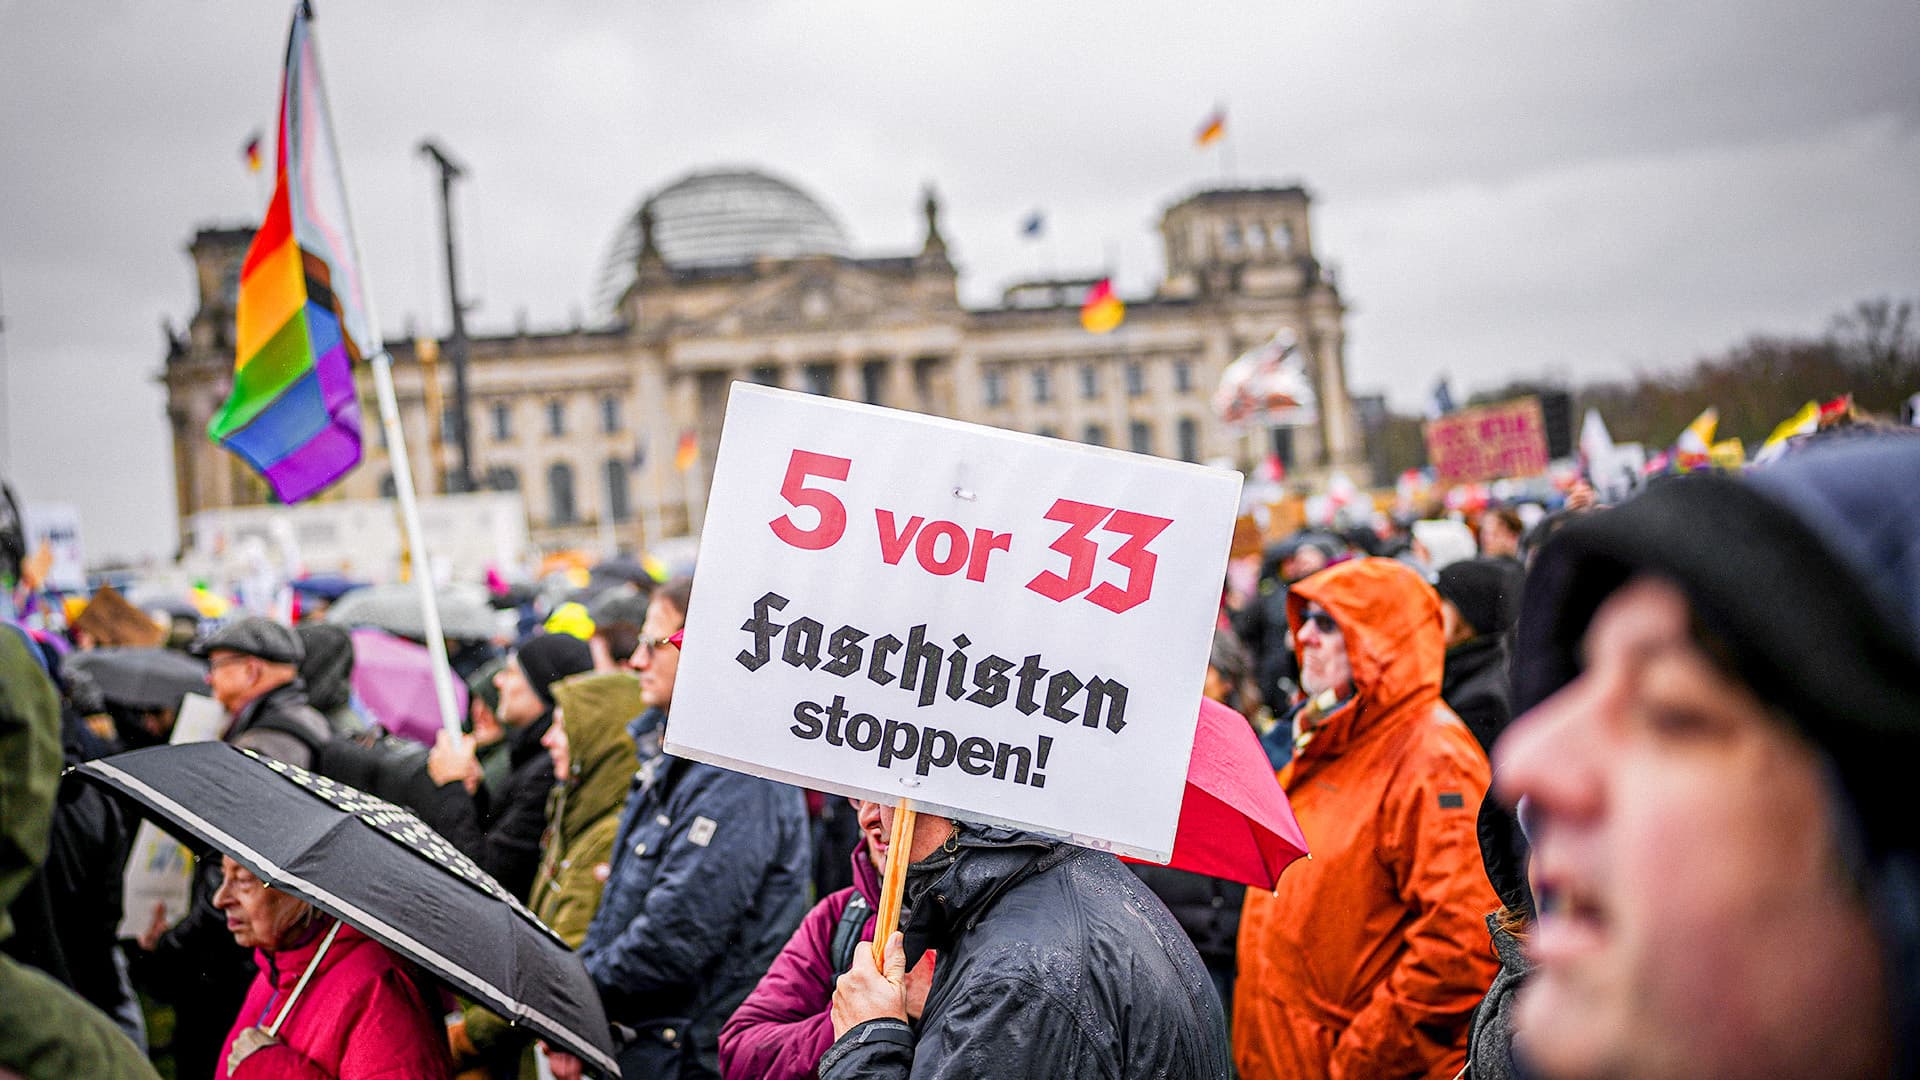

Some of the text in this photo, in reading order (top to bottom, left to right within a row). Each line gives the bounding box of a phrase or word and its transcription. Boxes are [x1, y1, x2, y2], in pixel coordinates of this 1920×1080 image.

[769, 449, 1174, 614] 5 vor 33
[790, 695, 1054, 789] stoppen!
